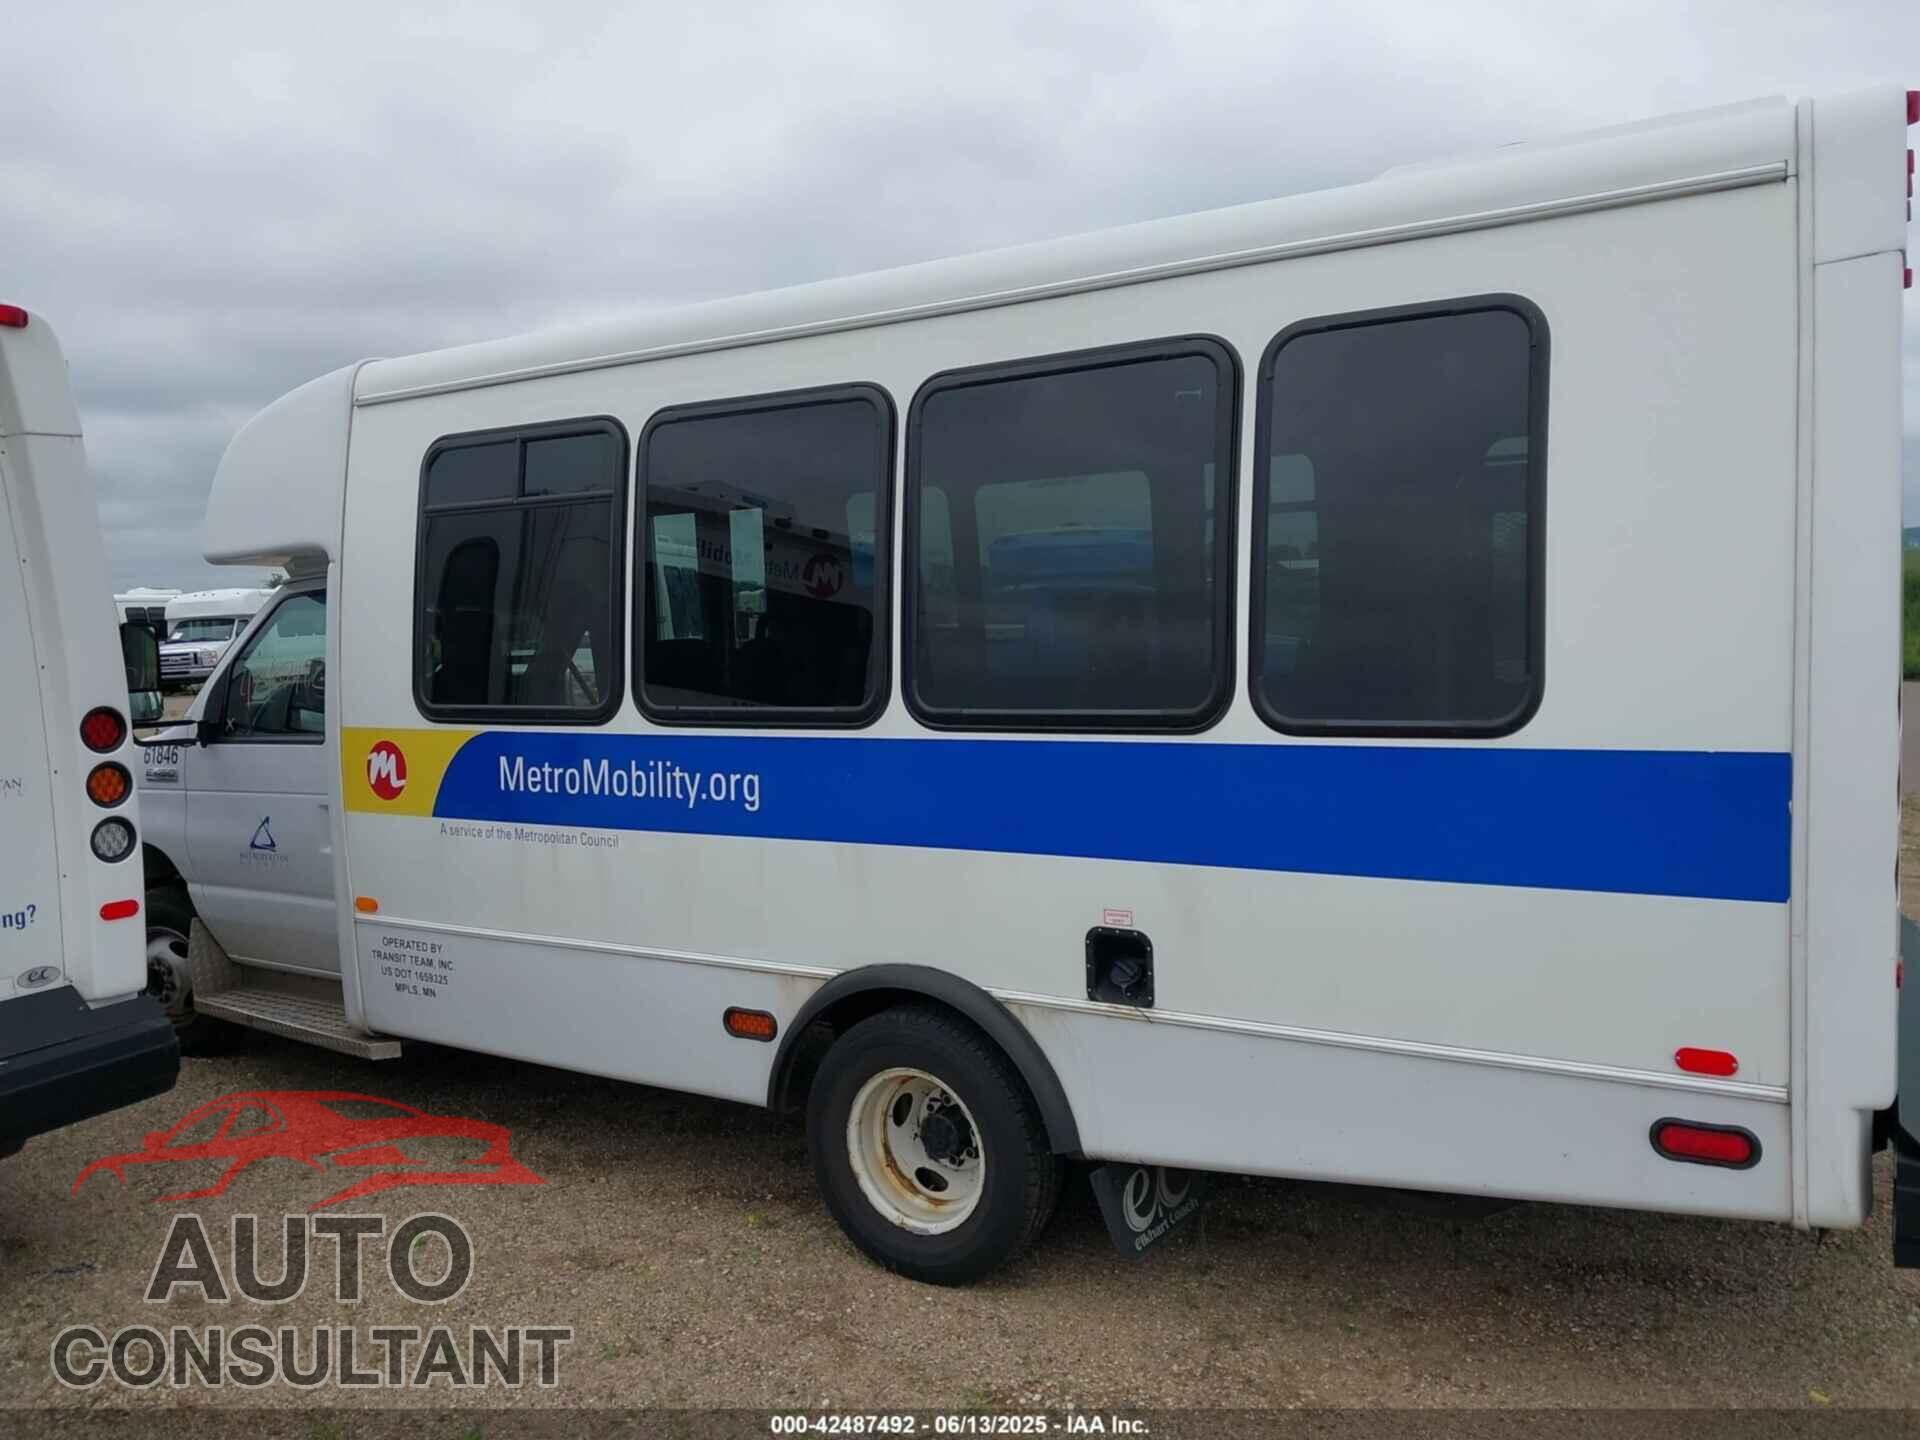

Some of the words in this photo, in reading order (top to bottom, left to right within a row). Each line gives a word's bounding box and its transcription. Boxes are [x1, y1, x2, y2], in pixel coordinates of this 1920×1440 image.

[144, 745, 178, 765] 61846
[499, 756, 760, 813] MetroMobility.org
[440, 823, 447, 835] A
[450, 825, 483, 838] service
[485, 827, 495, 839] of
[496, 828, 512, 841] the
[514, 828, 577, 846] Metropolitan
[580, 832, 619, 848] Council
[382, 936, 428, 952] OPERATED
[430, 943, 443, 953] BY
[371, 950, 407, 963] TRANSIT
[381, 965, 392, 976] US
[395, 967, 411, 979] DOT
[422, 986, 437, 998] MN
